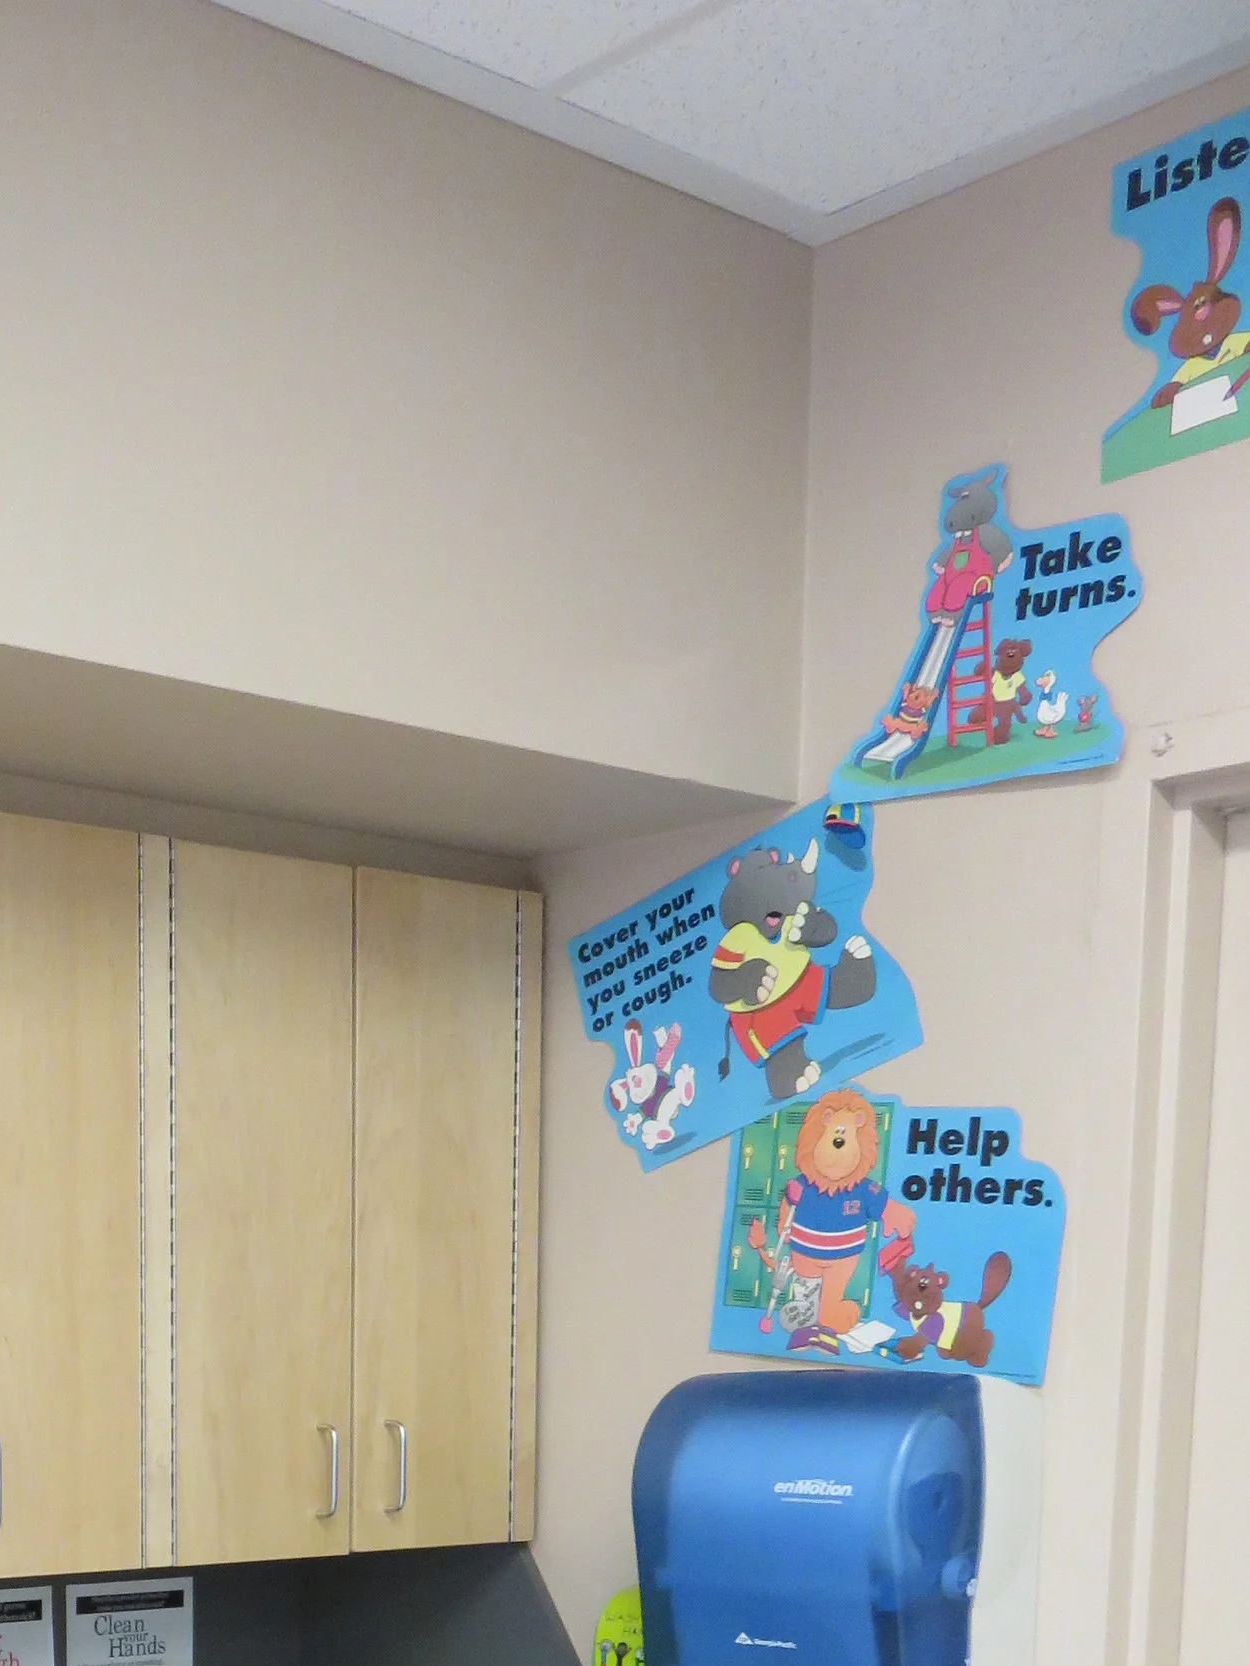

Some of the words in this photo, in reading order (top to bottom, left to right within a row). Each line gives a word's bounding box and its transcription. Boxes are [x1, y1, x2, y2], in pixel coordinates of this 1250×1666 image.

[1020, 531, 1122, 580] Take
[1015, 575, 1136, 621] turns.
[578, 920, 638, 963] Cover
[645, 887, 695, 932] your
[583, 939, 650, 988] mouth
[656, 903, 715, 946] when
[586, 980, 625, 1016] you
[634, 935, 708, 986] sneeze
[592, 1011, 614, 1032] or
[622, 971, 692, 1017] cough.
[906, 1116, 1010, 1166] Help
[843, 1200, 860, 1215] 12
[901, 1164, 1053, 1207] others.
[773, 1478, 853, 1496] enMotion
[94, 1614, 144, 1636] Clean
[109, 1636, 166, 1658] Hands
[123, 1632, 148, 1643] your
